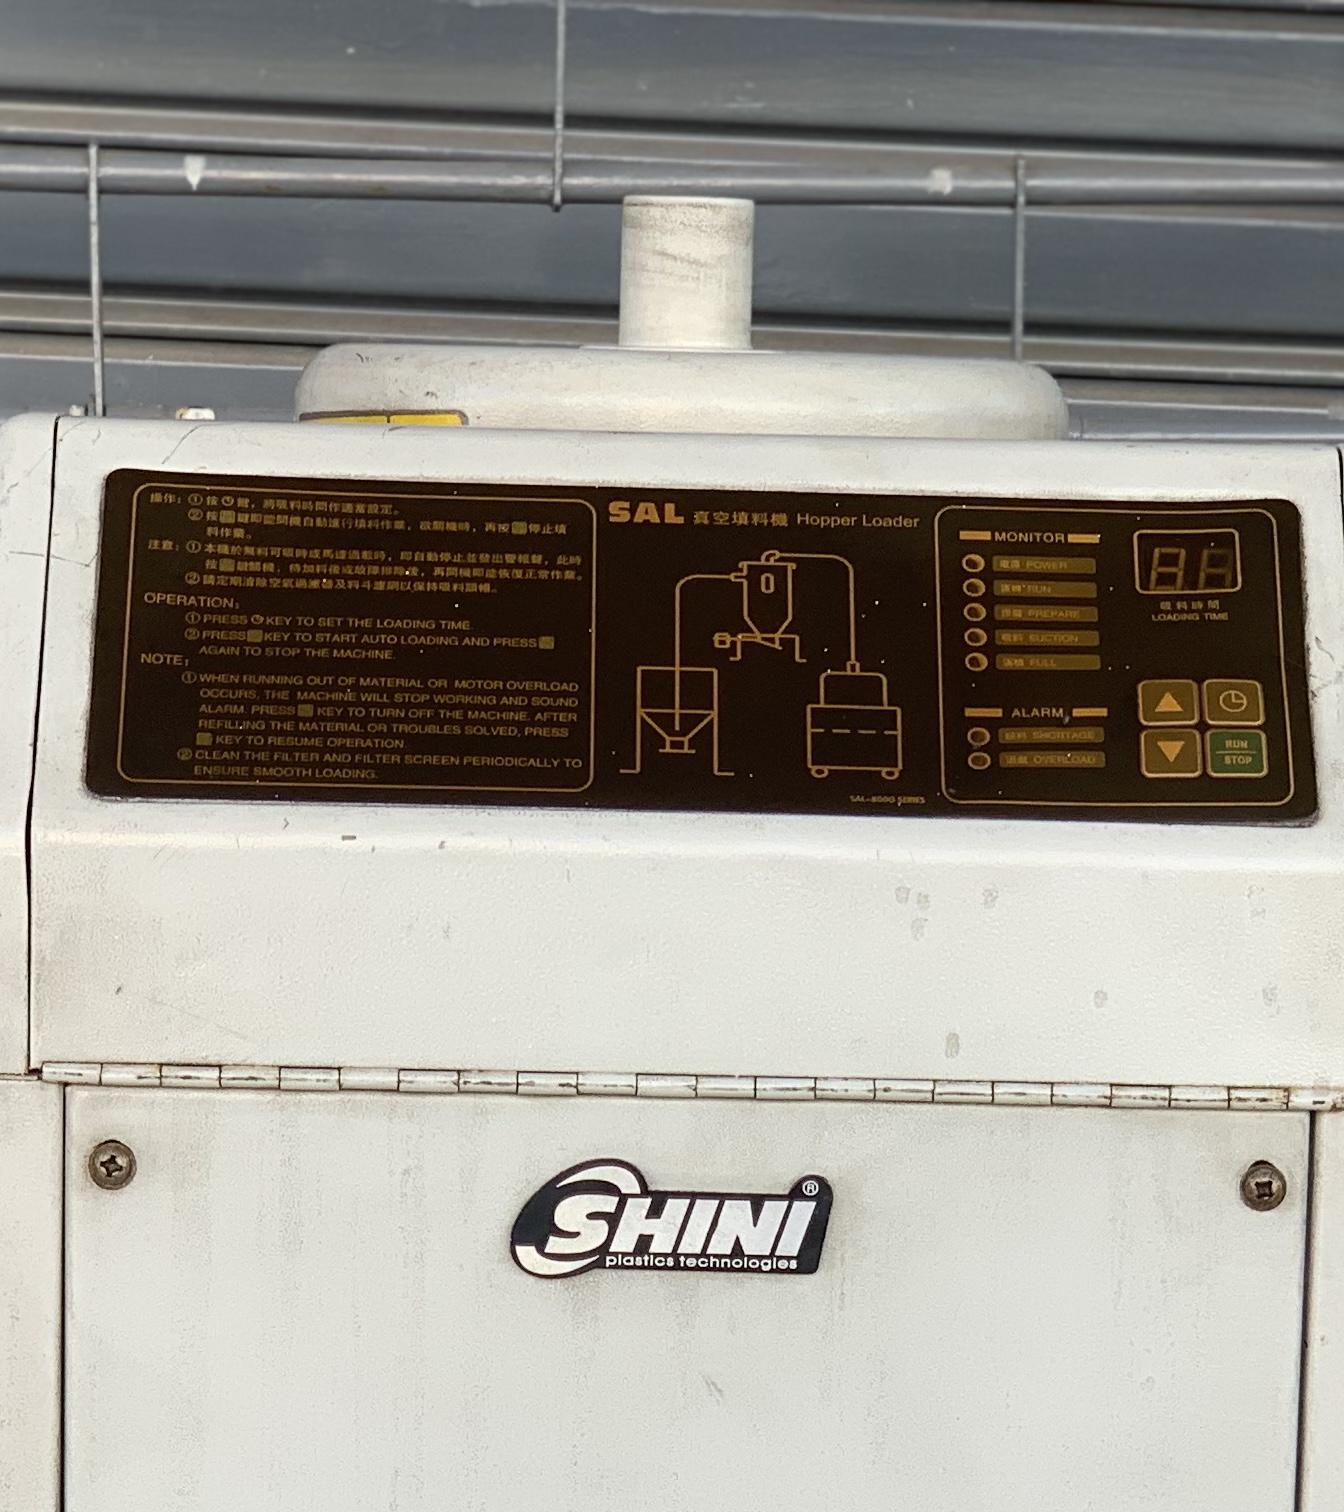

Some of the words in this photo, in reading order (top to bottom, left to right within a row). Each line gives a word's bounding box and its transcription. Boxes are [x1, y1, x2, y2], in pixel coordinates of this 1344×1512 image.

[608, 501, 685, 524] SAL
[797, 512, 857, 529] Hopper
[861, 513, 920, 529] Loader
[994, 532, 1066, 543] MONITOR
[1026, 560, 1067, 569] POWER
[1027, 585, 1051, 593] RUN
[203, 614, 248, 625] PRESS
[265, 616, 292, 626] KEY
[296, 616, 314, 627] TO
[317, 617, 343, 627] SET
[349, 617, 373, 628] THE
[376, 618, 435, 629] LOADING
[1151, 612, 1200, 622] LOADING
[1204, 612, 1229, 621] TIME
[202, 630, 246, 640] PRESS
[264, 632, 290, 642] KEY
[294, 632, 312, 643] TO
[315, 633, 356, 644] START
[361, 634, 397, 644] AUTO
[401, 635, 458, 646] LOADING
[462, 636, 490, 647] AND
[493, 637, 537, 648] PRESS
[199, 645, 240, 656] AGAIN
[243, 646, 262, 656] TO
[265, 647, 300, 658] STOP
[304, 648, 330, 658] THE
[199, 673, 239, 684] WHEN
[243, 675, 303, 685] RUNNING
[306, 676, 333, 686] OUT
[337, 676, 356, 687] OF
[359, 676, 424, 688] MATERIAL
[427, 678, 447, 688] OR
[454, 679, 504, 690] MOTOR
[506, 680, 579, 692] OVERLOAD
[265, 690, 290, 700] THE
[296, 691, 356, 702] MACHINE
[360, 691, 387, 702] WILL
[394, 692, 430, 703] STOP
[433, 694, 496, 705] WORKING
[499, 695, 528, 706] AND
[531, 696, 578, 707] SOUND
[251, 705, 296, 716] PRESS
[317, 706, 344, 717] KEY
[347, 707, 365, 717] TO
[369, 707, 405, 718] TURN
[408, 708, 434, 718] OFF
[438, 709, 463, 720] THE
[534, 711, 577, 722] AFTER
[1011, 707, 1065, 718] ALARM
[269, 720, 295, 731] THE
[299, 721, 364, 733] MATERIAL
[367, 723, 387, 733] OR
[392, 723, 461, 735] TROUBLES
[524, 727, 569, 738] PRESS
[216, 735, 242, 745] KEY
[246, 736, 264, 746] TO
[267, 736, 323, 747] RESUME
[1225, 739, 1248, 749] RUN
[195, 750, 240, 760] CLEAN
[243, 751, 268, 761] THE
[273, 751, 320, 762] FILTER
[323, 752, 352, 763] AND
[354, 753, 401, 764] FILTER
[405, 754, 459, 765] SCREEN
[463, 756, 559, 768] PERIODICALLY
[563, 758, 582, 769] TO
[1033, 755, 1096, 764] OVERLOAD
[1224, 755, 1253, 765] STOP
[253, 766, 312, 777] SMOOTH
[544, 1193, 817, 1257] SHINI
[605, 1256, 674, 1269] plastics
[679, 1256, 798, 1272] technologies
